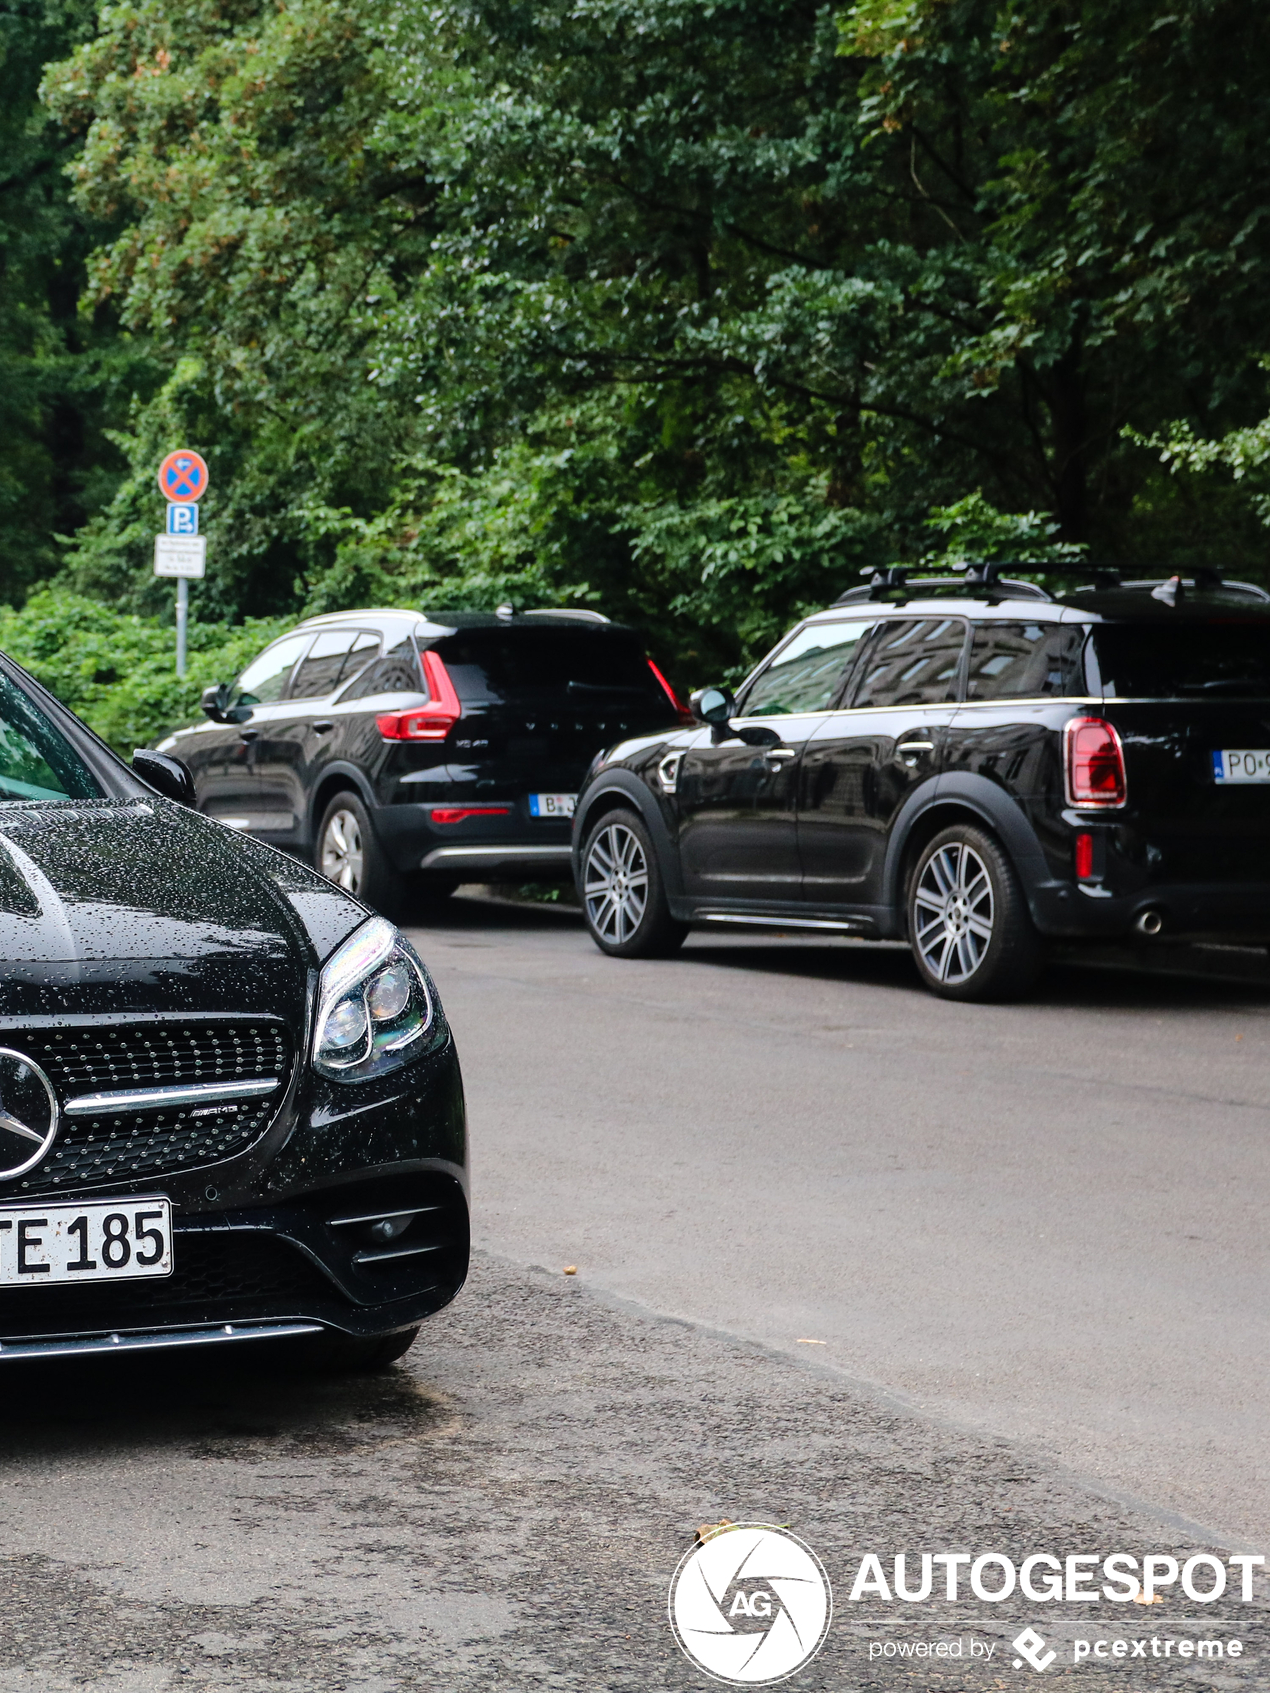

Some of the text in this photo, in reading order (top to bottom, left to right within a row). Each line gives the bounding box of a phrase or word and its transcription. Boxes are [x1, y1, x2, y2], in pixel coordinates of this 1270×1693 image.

[174, 507, 192, 532] P
[546, 797, 556, 812] B
[67, 1211, 164, 1272] 185
